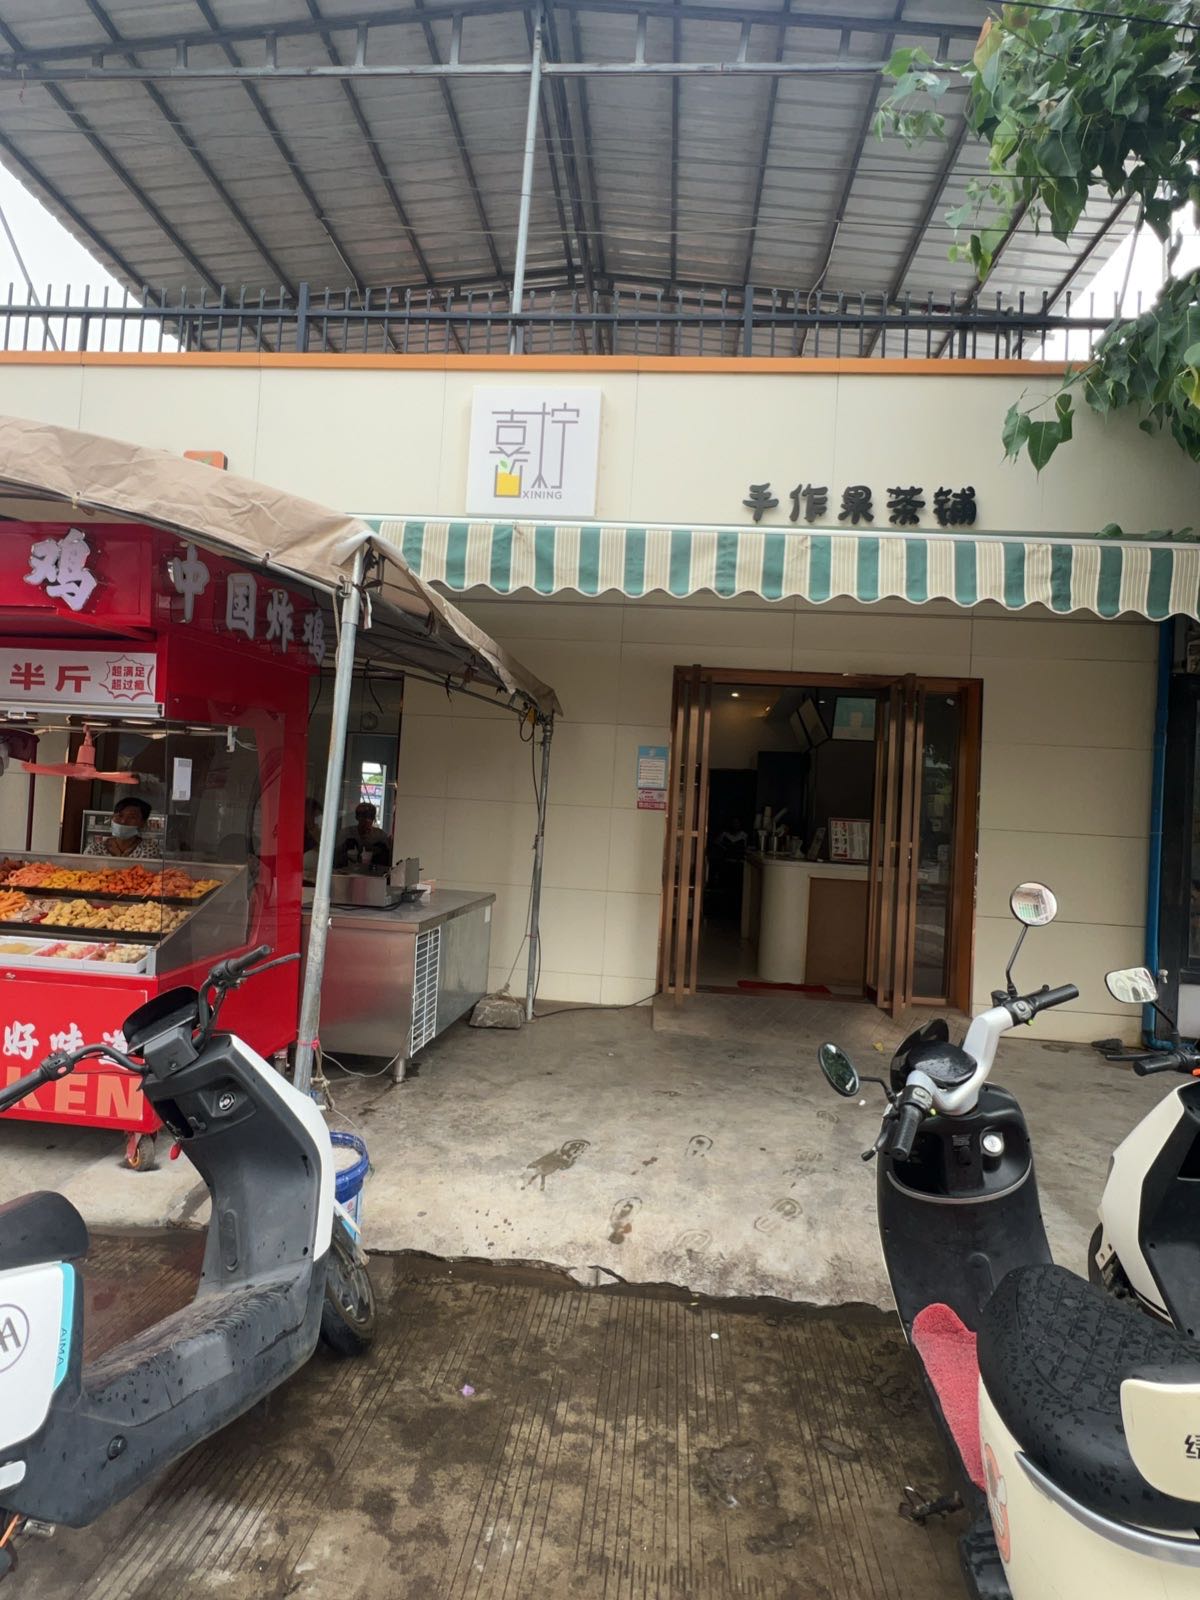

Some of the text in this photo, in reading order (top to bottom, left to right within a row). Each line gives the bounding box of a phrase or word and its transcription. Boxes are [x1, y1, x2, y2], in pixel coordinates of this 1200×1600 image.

[522, 490, 562, 500] XINING
[742, 482, 978, 527] 手作果茶铺
[167, 542, 326, 665] 中国炸鸡
[9, 662, 92, 694] 半斤
[111, 666, 145, 678] 超满足
[111, 679, 145, 691] 超过瘾
[56, 1327, 68, 1366] AIMA
